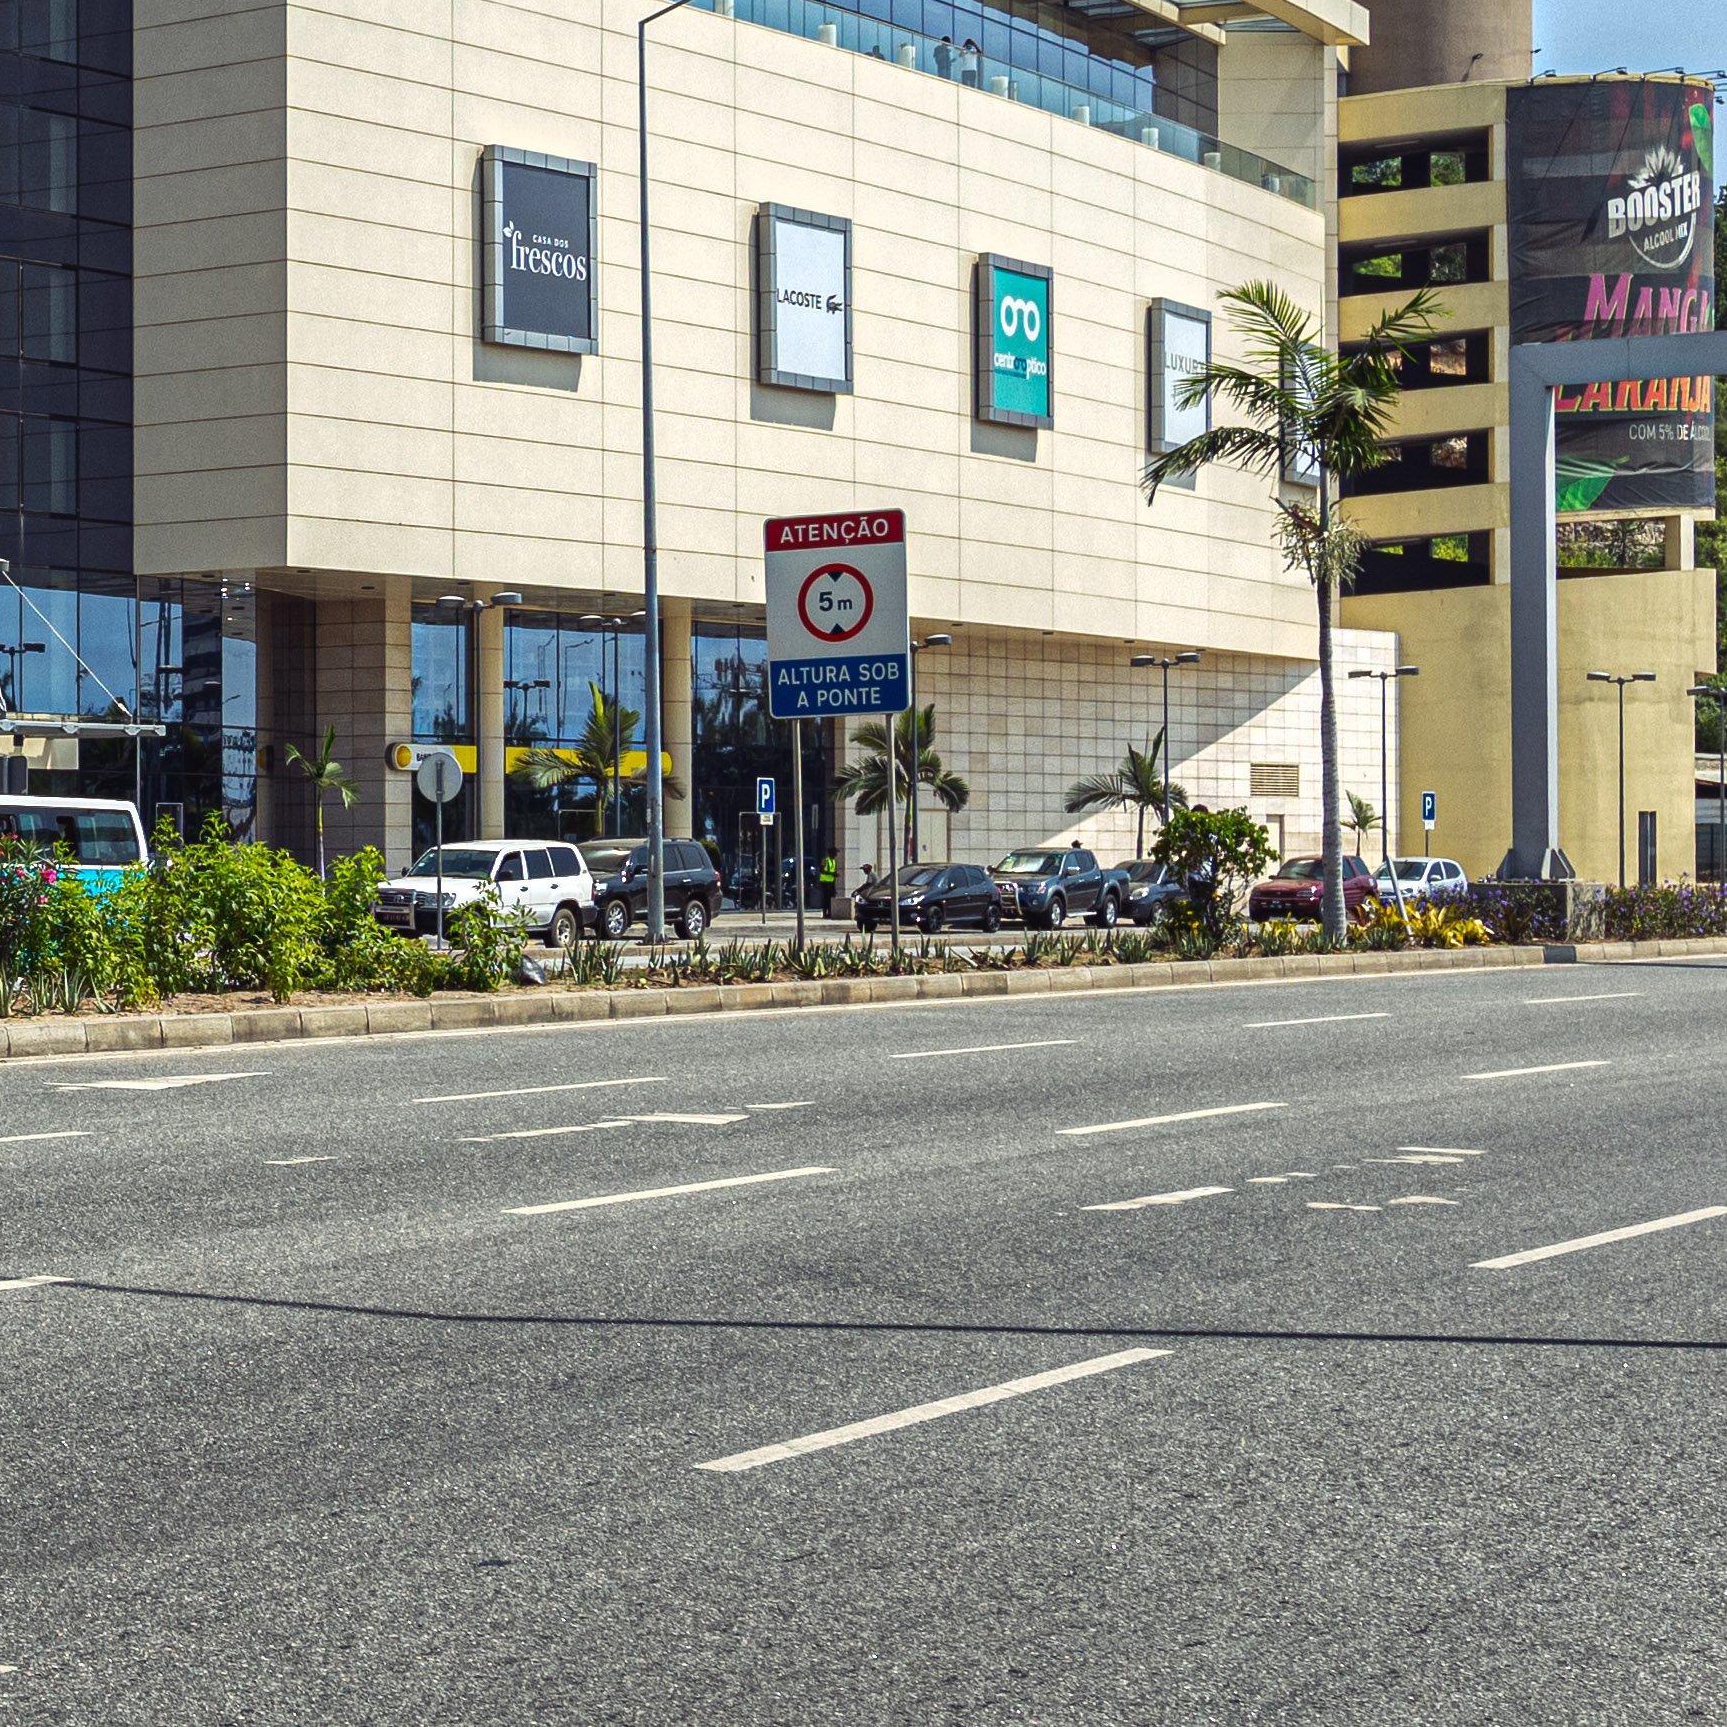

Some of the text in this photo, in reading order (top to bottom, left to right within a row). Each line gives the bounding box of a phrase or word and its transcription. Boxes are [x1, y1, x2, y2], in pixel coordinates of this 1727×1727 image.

[1607, 170, 1700, 239] BOOSTER
[532, 234, 569, 249] CASA DOS
[1643, 229, 1674, 253] ALCOOL
[510, 230, 587, 281] frescos
[776, 288, 822, 310] LACOSTE
[1164, 351, 1205, 375] LUXUR
[1629, 424, 1656, 440] COM
[1658, 423, 1674, 440] 5%
[1676, 424, 1689, 441] DE
[780, 517, 889, 544] ATENÇÃO
[819, 591, 853, 612] 5 m
[778, 662, 900, 685] ALTURA SOB
[797, 687, 882, 708] A PONTE
[761, 783, 771, 809] P
[1425, 796, 1433, 817] P
